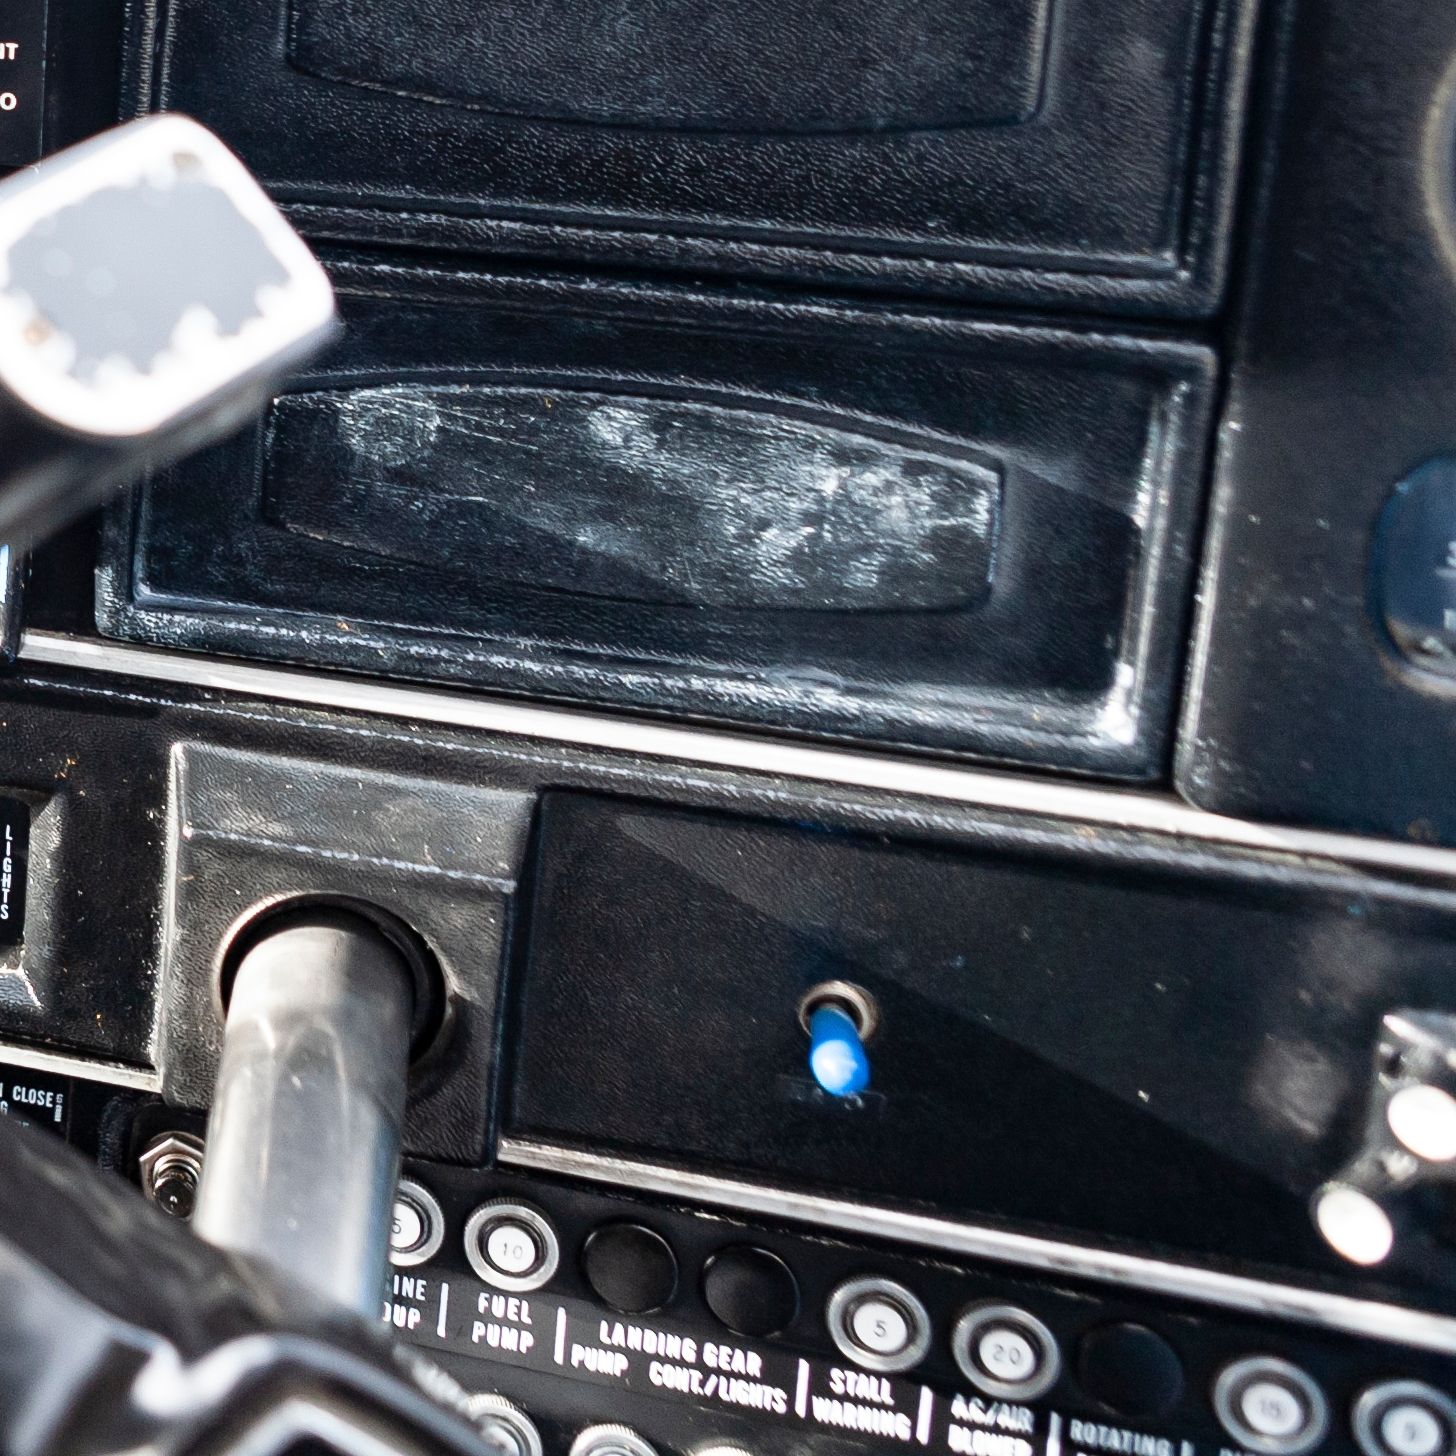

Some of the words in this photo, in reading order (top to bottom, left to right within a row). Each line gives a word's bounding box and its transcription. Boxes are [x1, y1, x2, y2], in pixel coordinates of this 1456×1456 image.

[0, 824, 13, 920] LIGHTS
[12, 1085, 54, 1108] CLOSE
[501, 1241, 524, 1261] 10
[477, 1291, 534, 1325] FUEL
[471, 1319, 535, 1355] PUMP
[873, 1318, 888, 1338] 5
[570, 1343, 630, 1380] PUMP
[598, 1319, 697, 1363] LANDING
[702, 1342, 763, 1379] GEAR
[992, 1346, 1023, 1366] 20
[829, 1366, 896, 1407] STALL
[812, 1393, 913, 1442] WARNING
[1069, 1418, 1174, 1456] ROTATING
